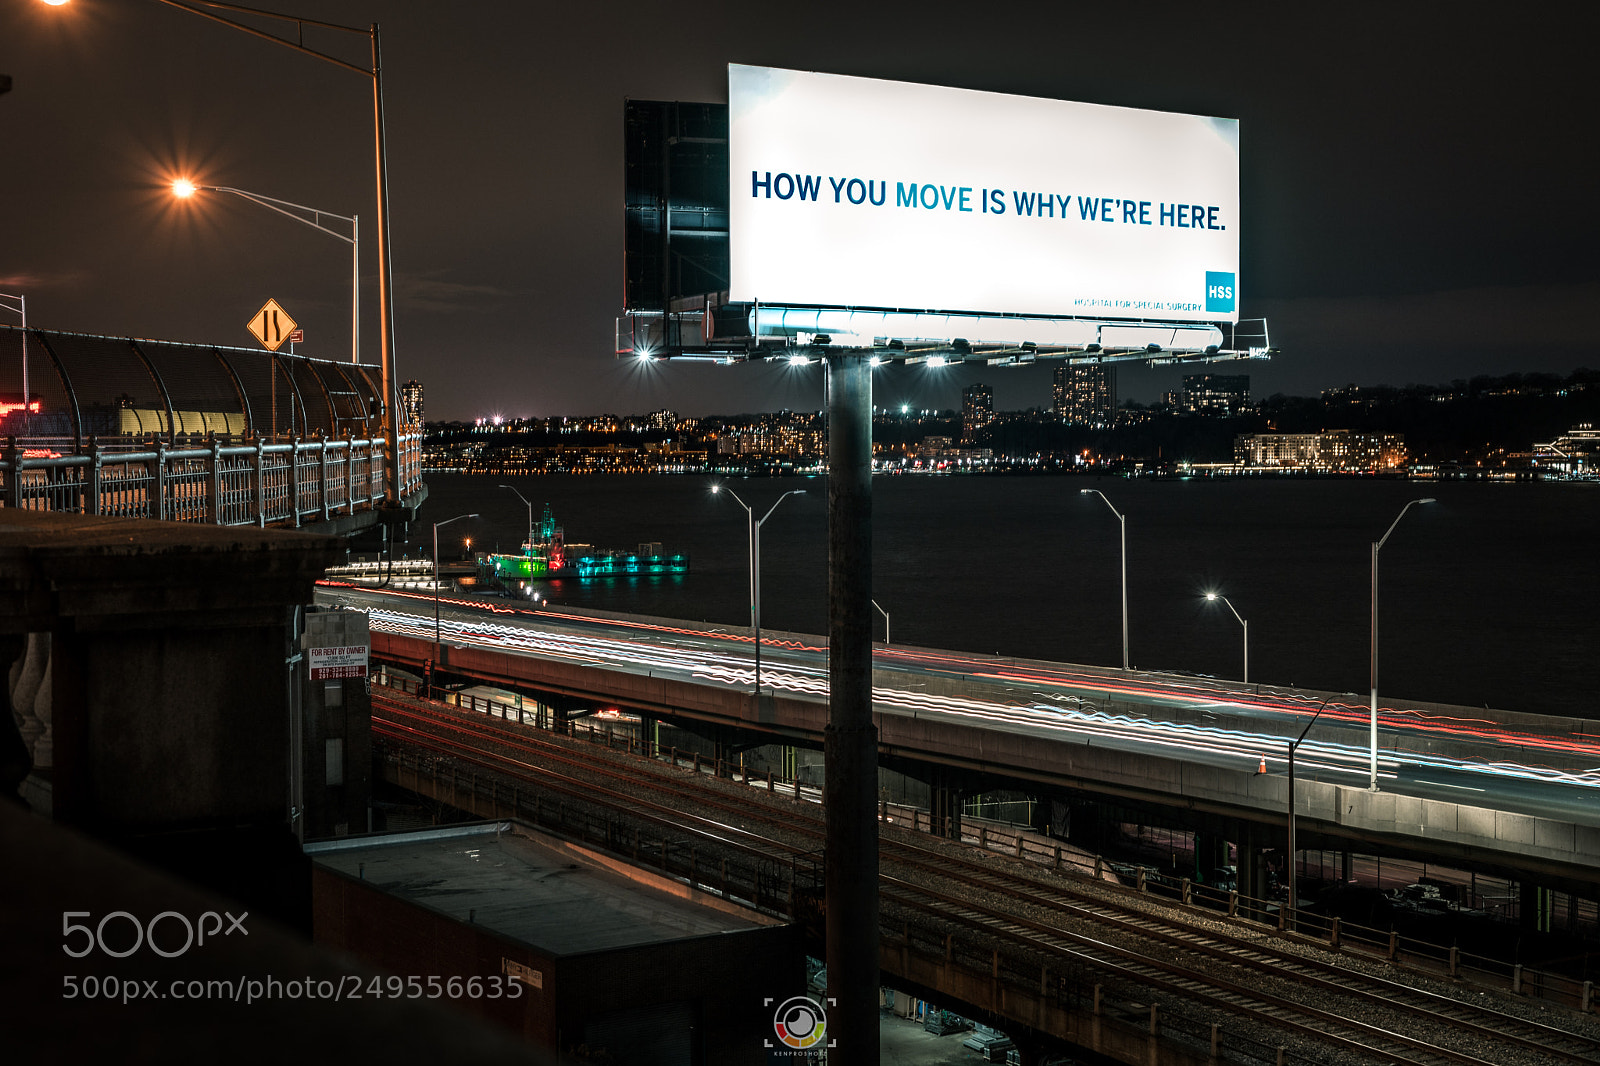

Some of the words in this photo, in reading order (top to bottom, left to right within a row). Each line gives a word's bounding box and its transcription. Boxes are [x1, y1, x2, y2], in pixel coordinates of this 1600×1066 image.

[752, 171, 822, 201] HOW
[829, 177, 886, 206] YOU
[897, 182, 972, 212] MOVE
[982, 188, 1006, 214] IS
[1013, 191, 1071, 219] WHY
[1078, 196, 1152, 225] WE'RE
[1160, 203, 1226, 231] HERE.
[1209, 285, 1232, 299] HSS
[1074, 299, 1112, 307] HOSPITAL
[1115, 300, 1131, 308] FOR
[1133, 301, 1164, 310] SPECIAL
[1167, 302, 1202, 311] SURGERY
[324, 648, 337, 656] RENT
[338, 647, 346, 655] BY
[346, 647, 366, 655] OWNER
